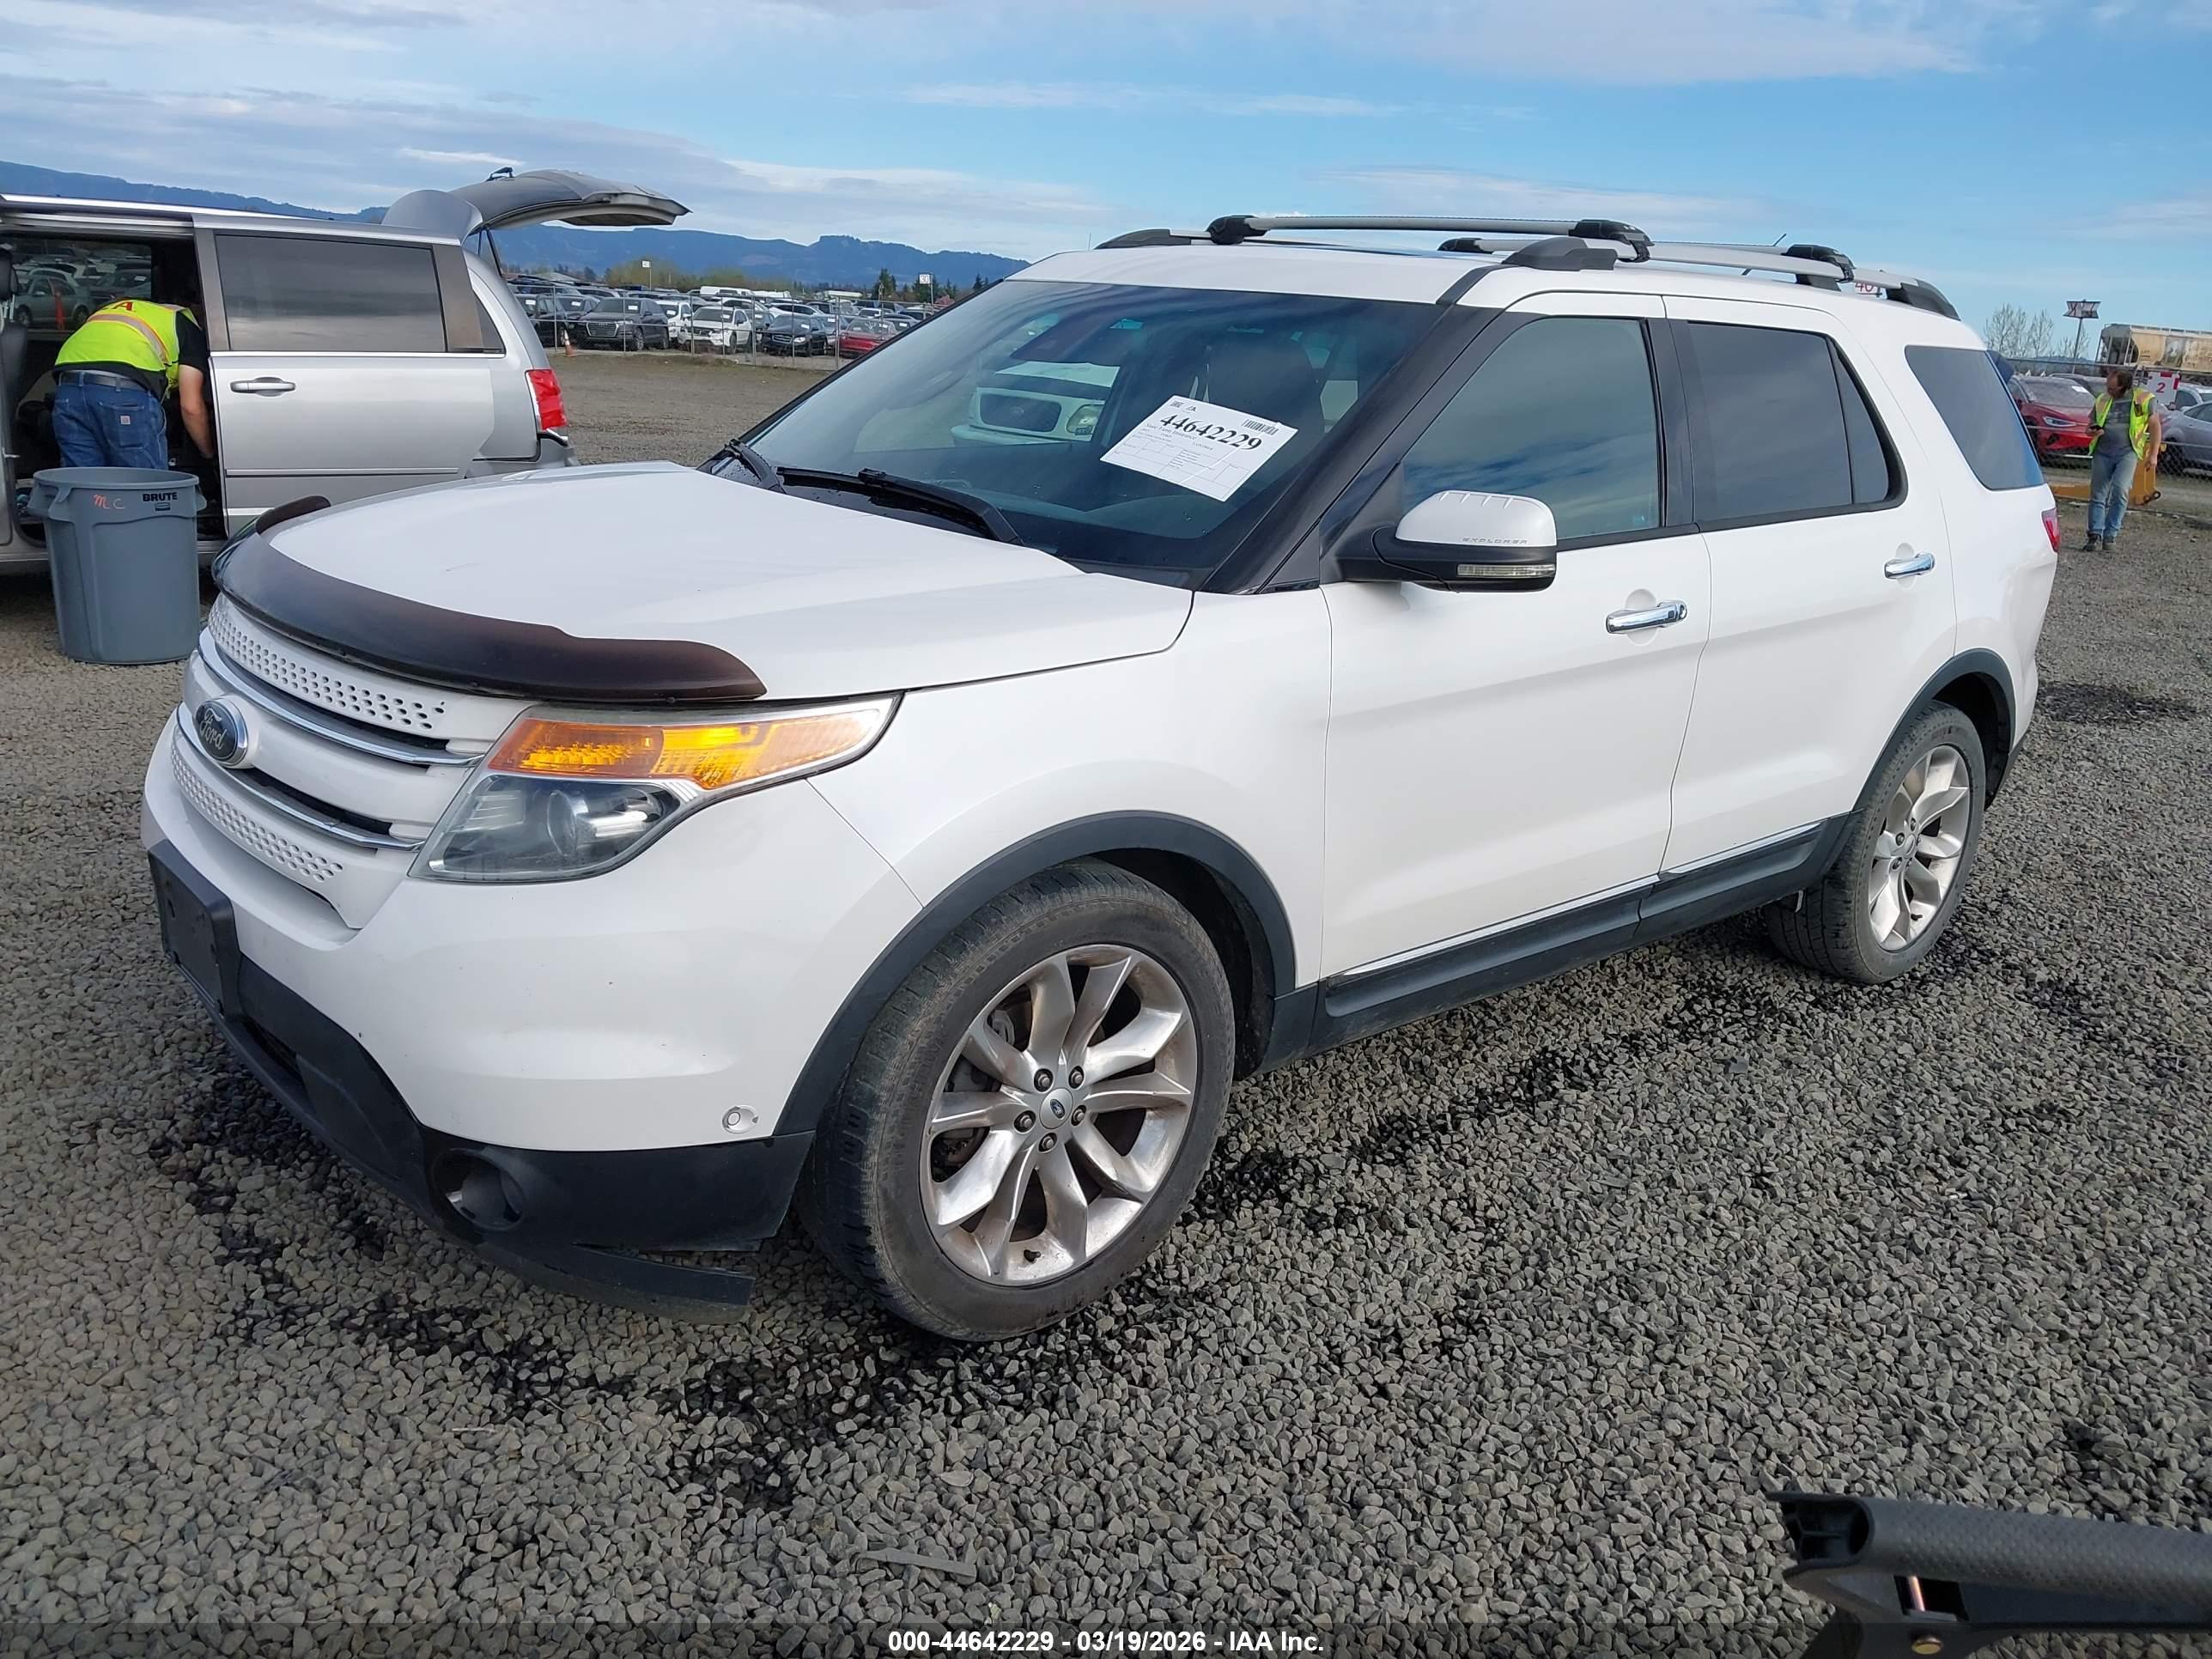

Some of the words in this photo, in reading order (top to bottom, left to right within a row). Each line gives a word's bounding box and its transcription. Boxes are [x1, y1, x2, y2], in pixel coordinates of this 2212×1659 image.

[2156, 382, 2166, 393] 2
[1159, 414, 1262, 451] 44642229
[142, 492, 178, 502] BRUTE
[199, 708, 228, 750] Ford
